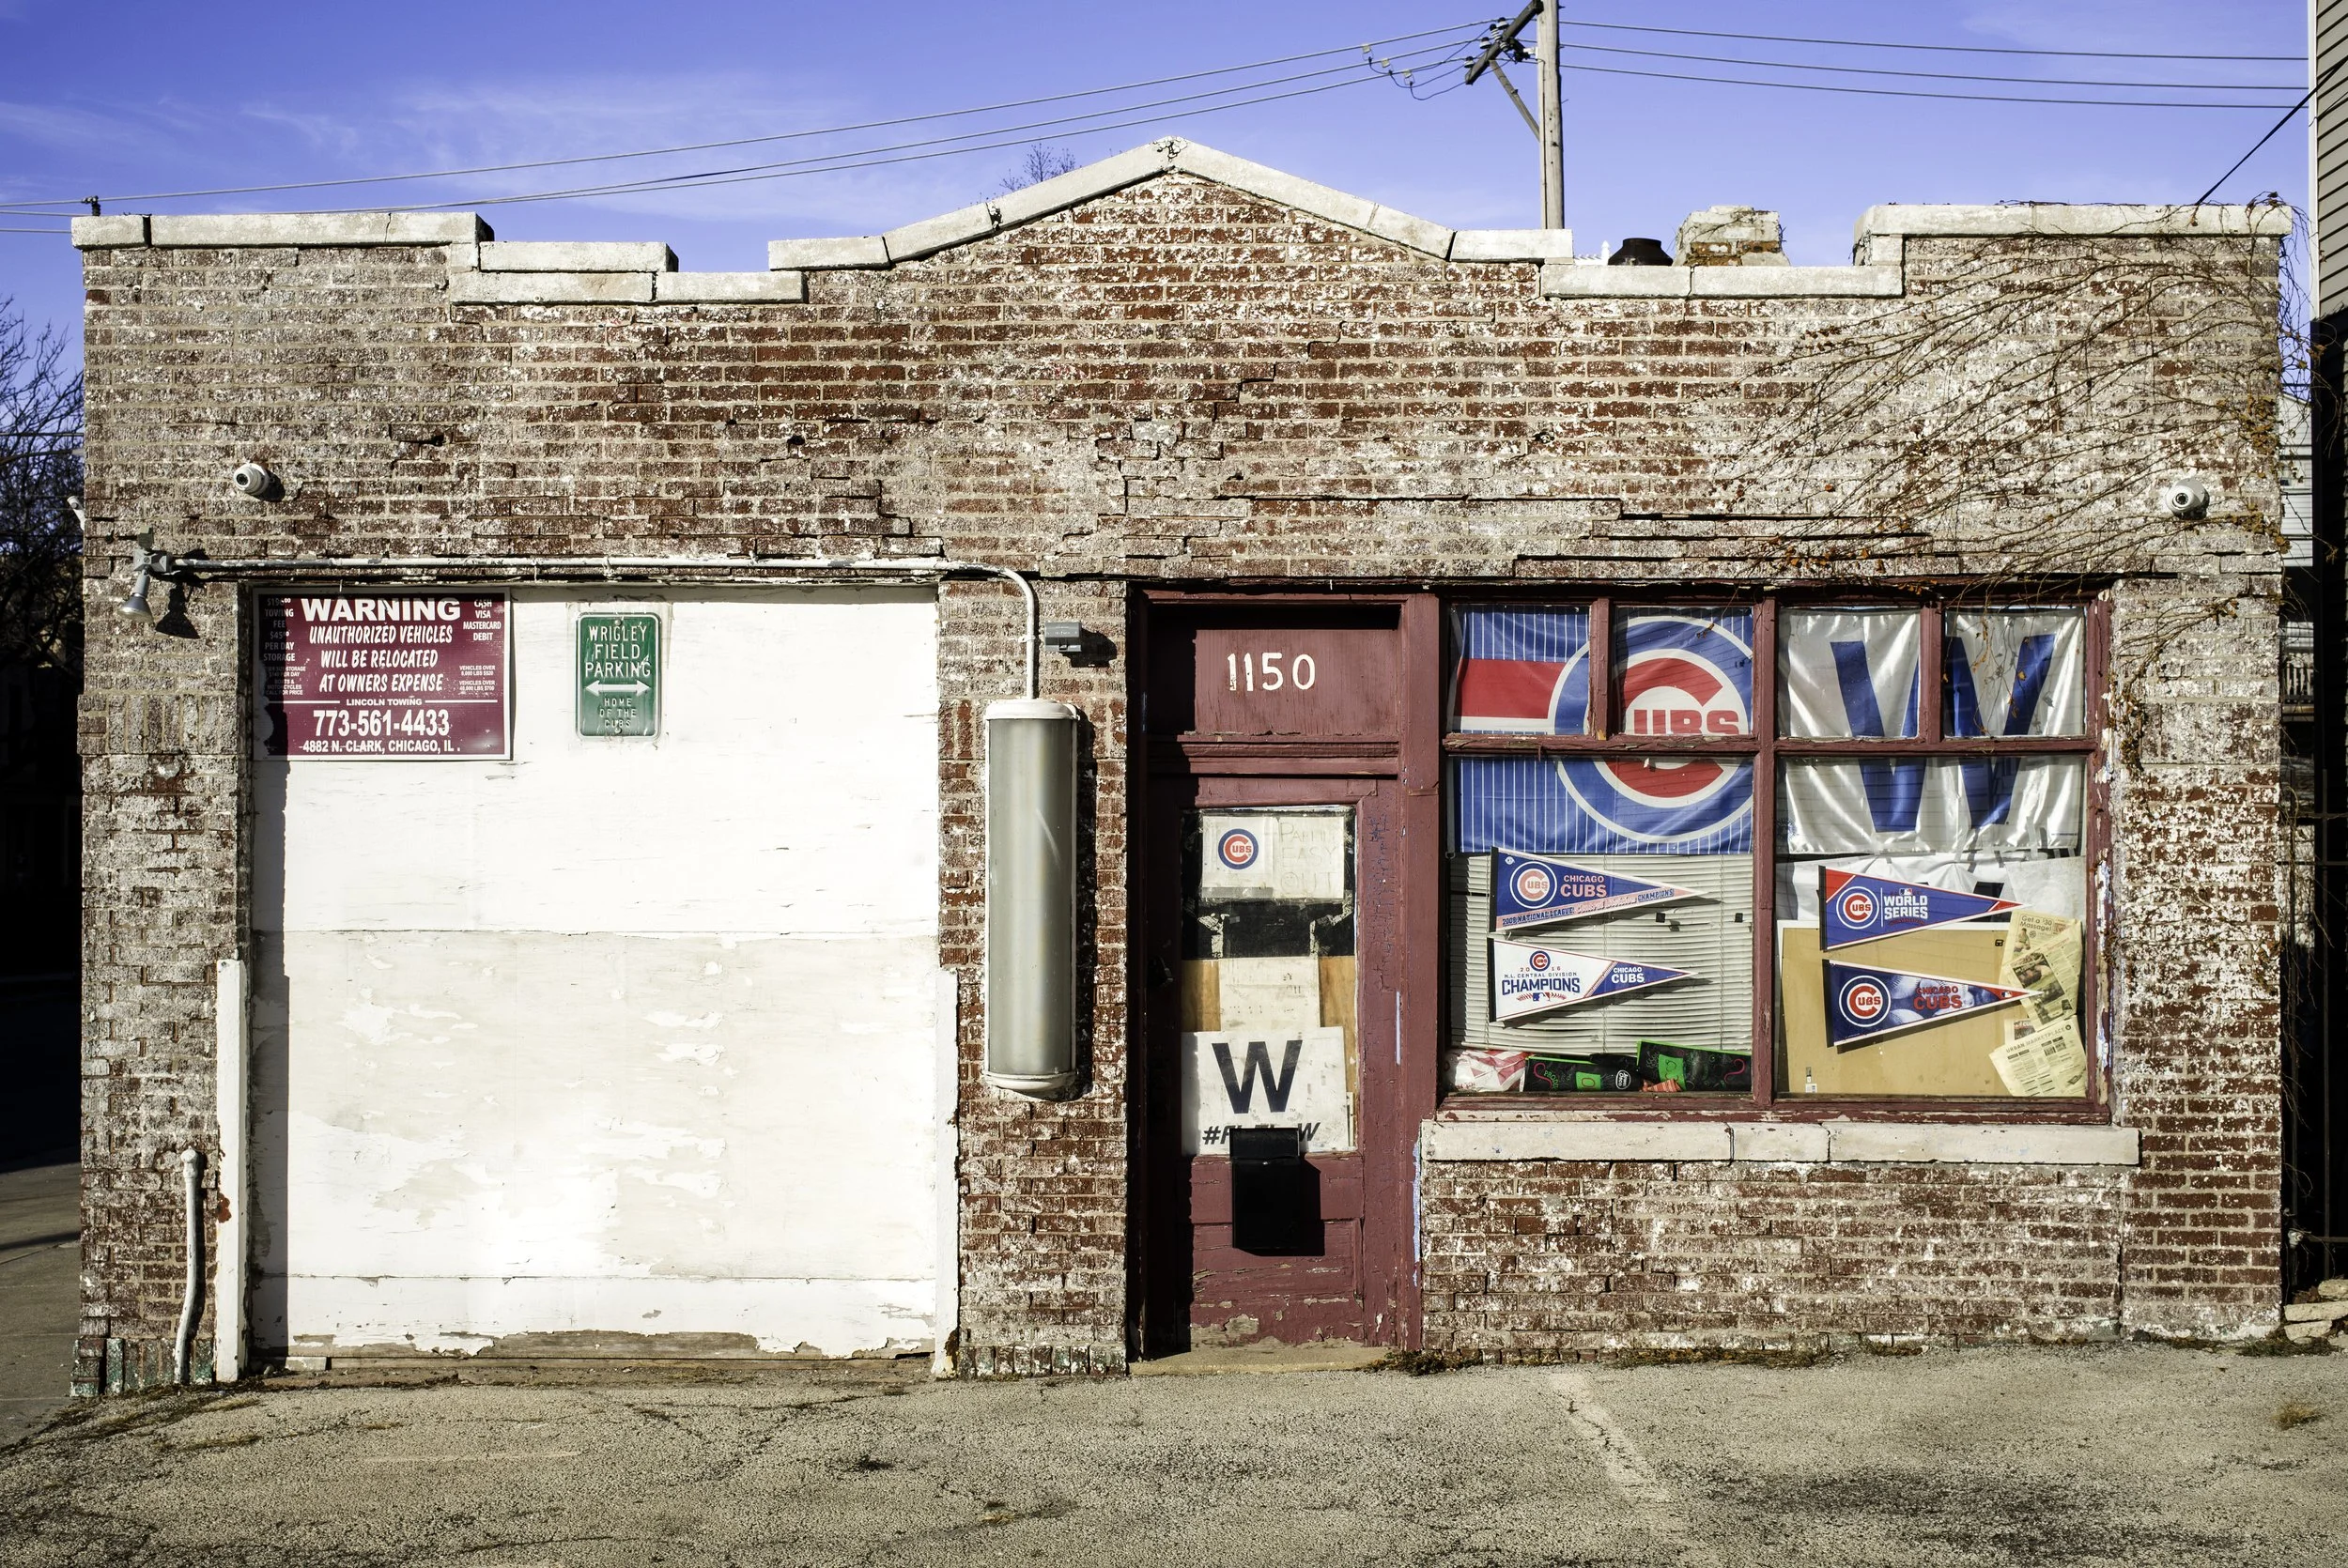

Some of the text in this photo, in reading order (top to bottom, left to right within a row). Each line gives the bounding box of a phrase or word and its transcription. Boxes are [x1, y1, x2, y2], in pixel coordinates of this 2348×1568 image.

[301, 597, 461, 622] WARNING
[474, 599, 492, 607] CASH
[264, 608, 294, 618] TOWING
[475, 610, 491, 619] VISA
[272, 620, 286, 628] FEE
[463, 622, 502, 630] MASTERCARD
[309, 624, 453, 644] UNAUTHORIZED VEHICLES
[472, 632, 494, 641] DEBIT
[588, 625, 648, 642] WRIGLEY
[264, 641, 295, 651] PER DAY
[595, 643, 641, 659] FIELD
[263, 653, 296, 662] STORAGE
[321, 649, 439, 669] WILL BE RELOCATED
[585, 661, 651, 678] PARKING
[1228, 652, 1316, 692] 1150
[318, 673, 444, 693] AT OWNERS EXPENSE
[387, 698, 423, 706] TOWING
[604, 698, 632, 707] HOME
[599, 708, 637, 718] OF THE
[313, 709, 450, 736] 773-561-4433
[604, 719, 631, 729] CUBS
[1830, 634, 2056, 833] W
[301, 740, 329, 753] 4882
[331, 740, 343, 752] N.
[346, 740, 385, 754] CLARK,
[388, 739, 440, 754] CHICAGO,
[1224, 835, 1252, 863] CUBS
[1519, 869, 1549, 900] CUBS
[1563, 874, 1605, 883] CHICAGO
[1560, 884, 1607, 898] CUBS
[1517, 912, 1549, 924] NATIONAL
[1550, 907, 1573, 918] LEAGUE
[1637, 888, 1675, 902] CHAMPIONS
[1845, 894, 1872, 921] CUBS
[1883, 895, 1928, 907] WORLD
[1884, 906, 1928, 920] SERIES
[2019, 921, 2052, 931] Massage!
[1611, 973, 1645, 983] CUBS
[1501, 977, 1581, 995] CHAMPIONS
[1915, 985, 1958, 995] CHICAGO
[1849, 985, 1881, 1017] CUBS
[1913, 995, 1962, 1010] CUBS
[2005, 1043, 2025, 1053] URBAN
[2026, 1027, 2065, 1046] MARKETPLACE
[1212, 1039, 1304, 1115] W
